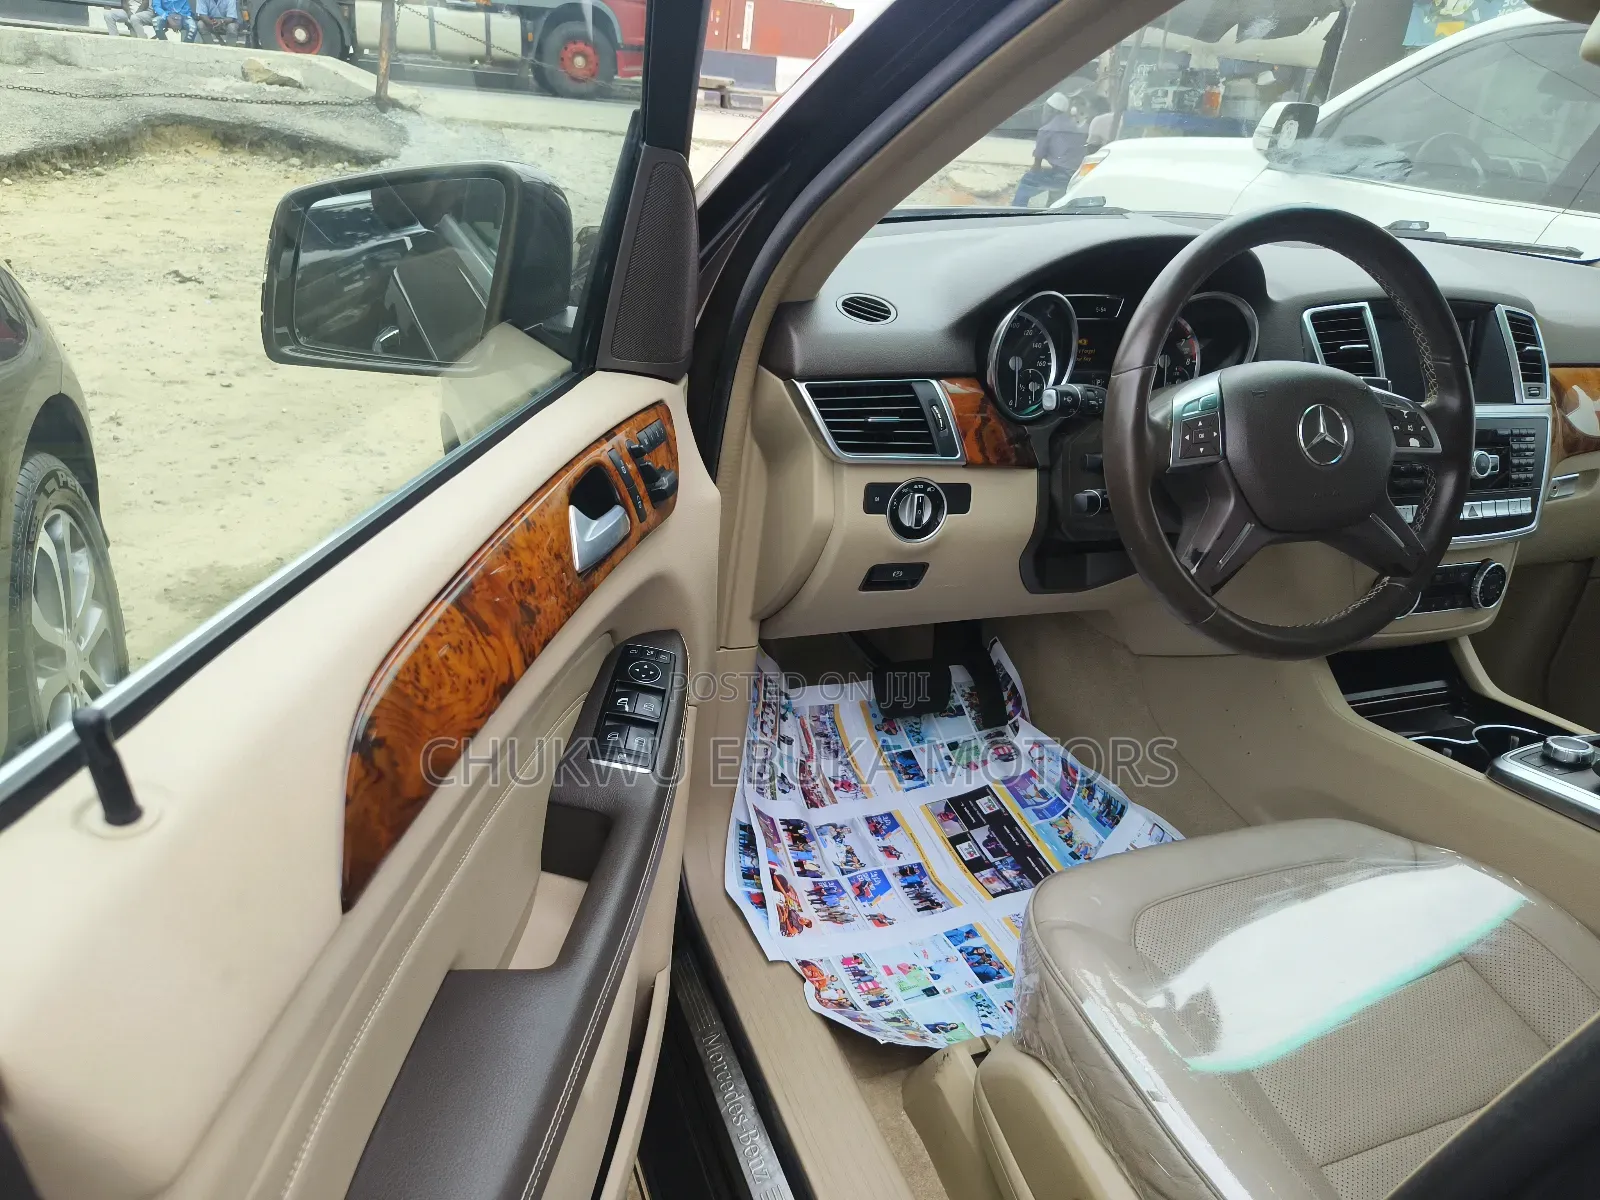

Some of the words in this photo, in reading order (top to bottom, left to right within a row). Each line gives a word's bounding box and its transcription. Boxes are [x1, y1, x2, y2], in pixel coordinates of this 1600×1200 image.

[1181, 338, 1186, 346] 7
[1185, 358, 1191, 366] 8
[702, 1032, 771, 1185] Mercedes-Benz
